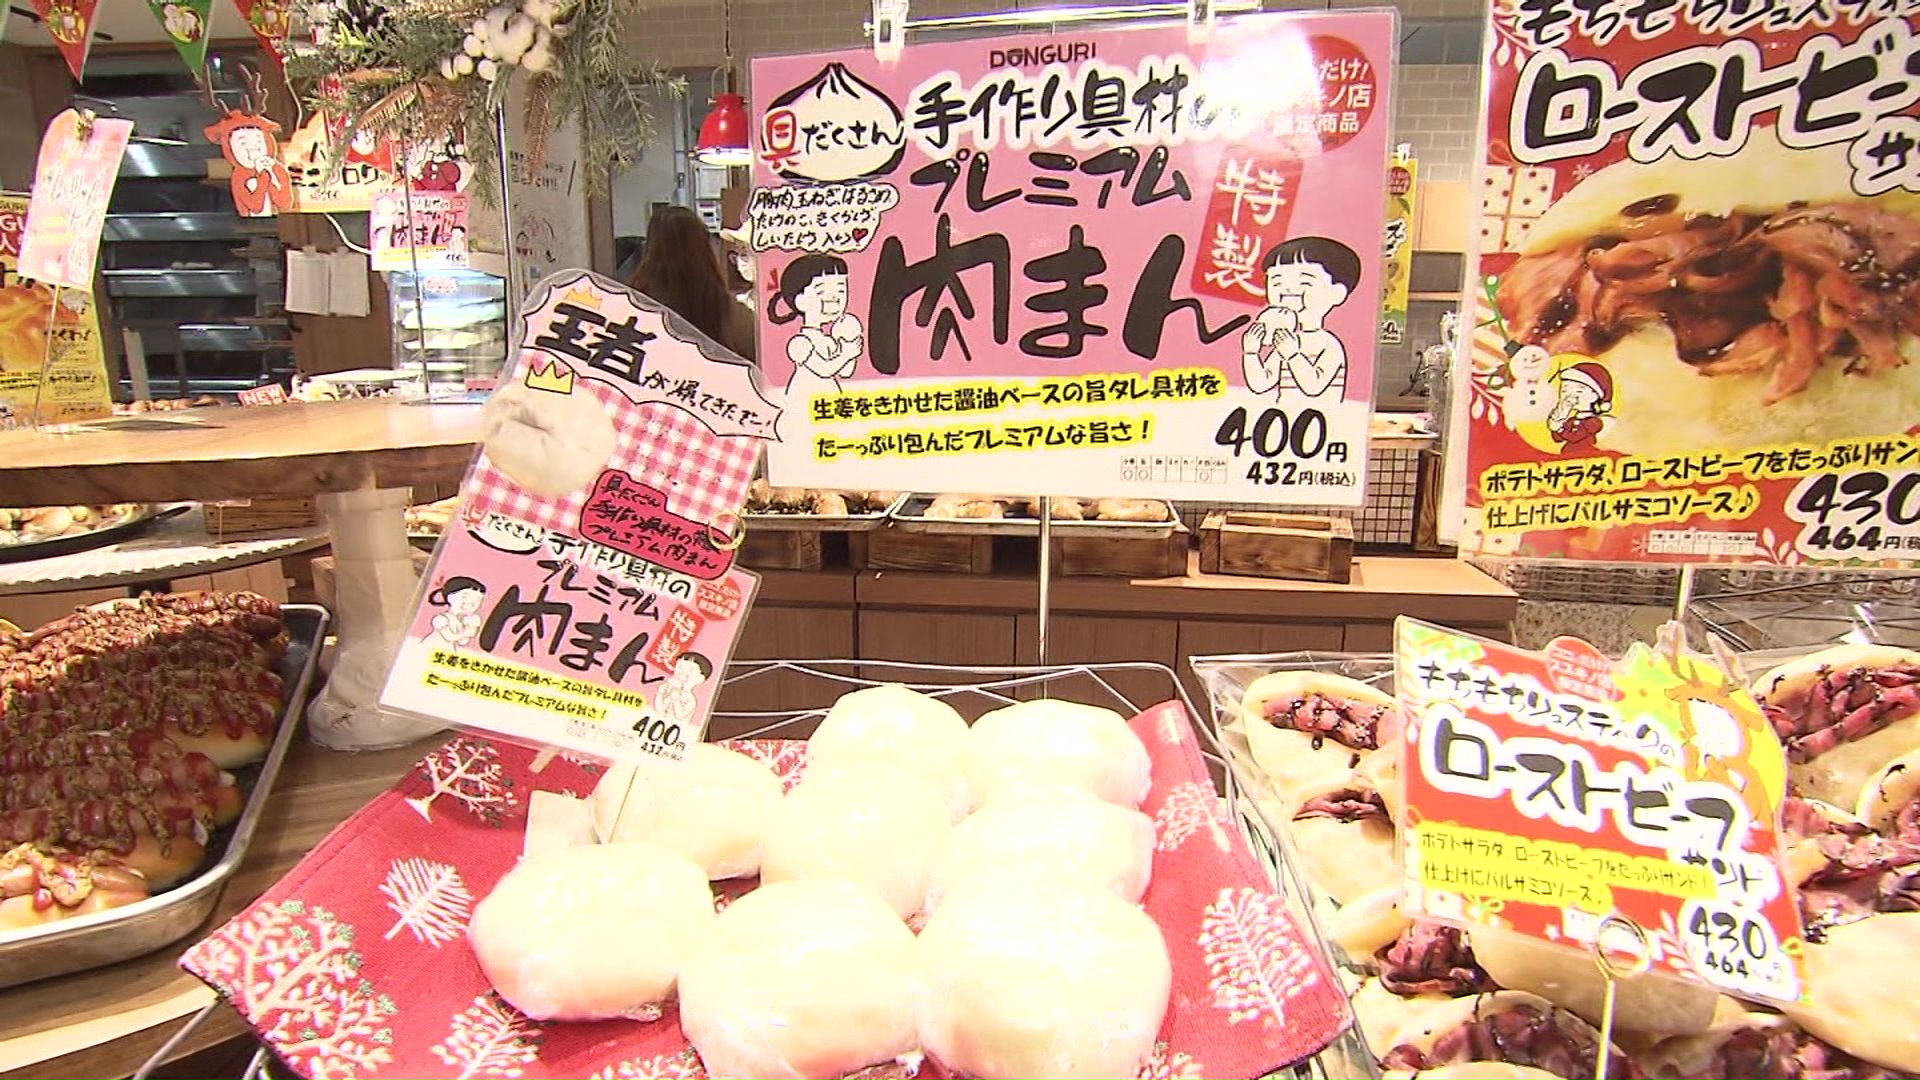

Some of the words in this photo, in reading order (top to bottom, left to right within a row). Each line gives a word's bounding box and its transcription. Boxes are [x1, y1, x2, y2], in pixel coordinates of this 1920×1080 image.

[990, 43, 1096, 69] DONGURI
[1525, 33, 1920, 148] ローストビー
[760, 109, 905, 170] 具だくさん
[910, 146, 1192, 214] プレミアム
[1206, 157, 1288, 297] 特製
[867, 212, 1250, 375] 肉まん
[243, 387, 284, 408] NEW
[1215, 406, 1348, 463] 400円
[1246, 461, 1356, 487] 432円(税込)
[536, 558, 659, 621] プレミアム
[479, 583, 665, 684] 肉まん
[1434, 718, 1737, 850] ローストビーフ
